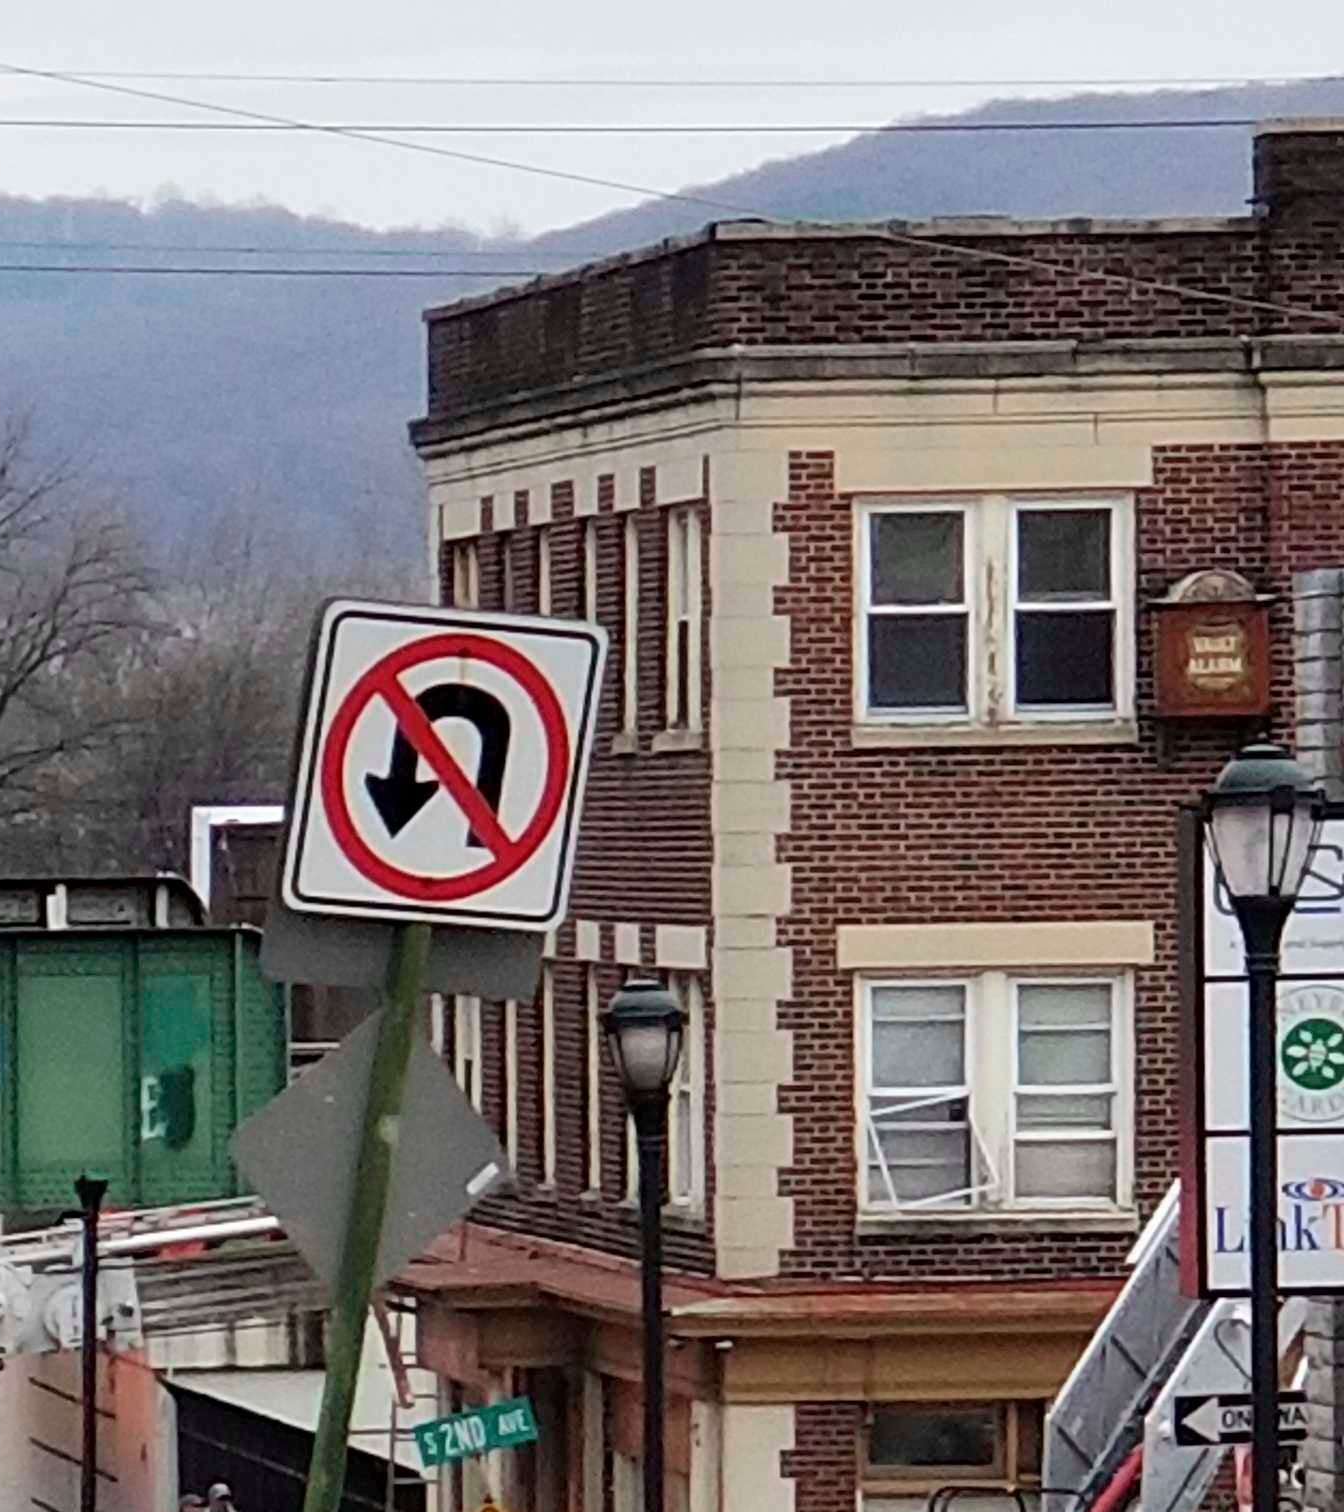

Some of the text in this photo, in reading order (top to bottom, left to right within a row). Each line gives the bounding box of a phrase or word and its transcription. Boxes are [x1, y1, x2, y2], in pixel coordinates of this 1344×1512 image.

[1193, 635, 1236, 653] VAULT
[1188, 657, 1243, 674] ALARM
[423, 1408, 530, 1457] S 2ND AVE
